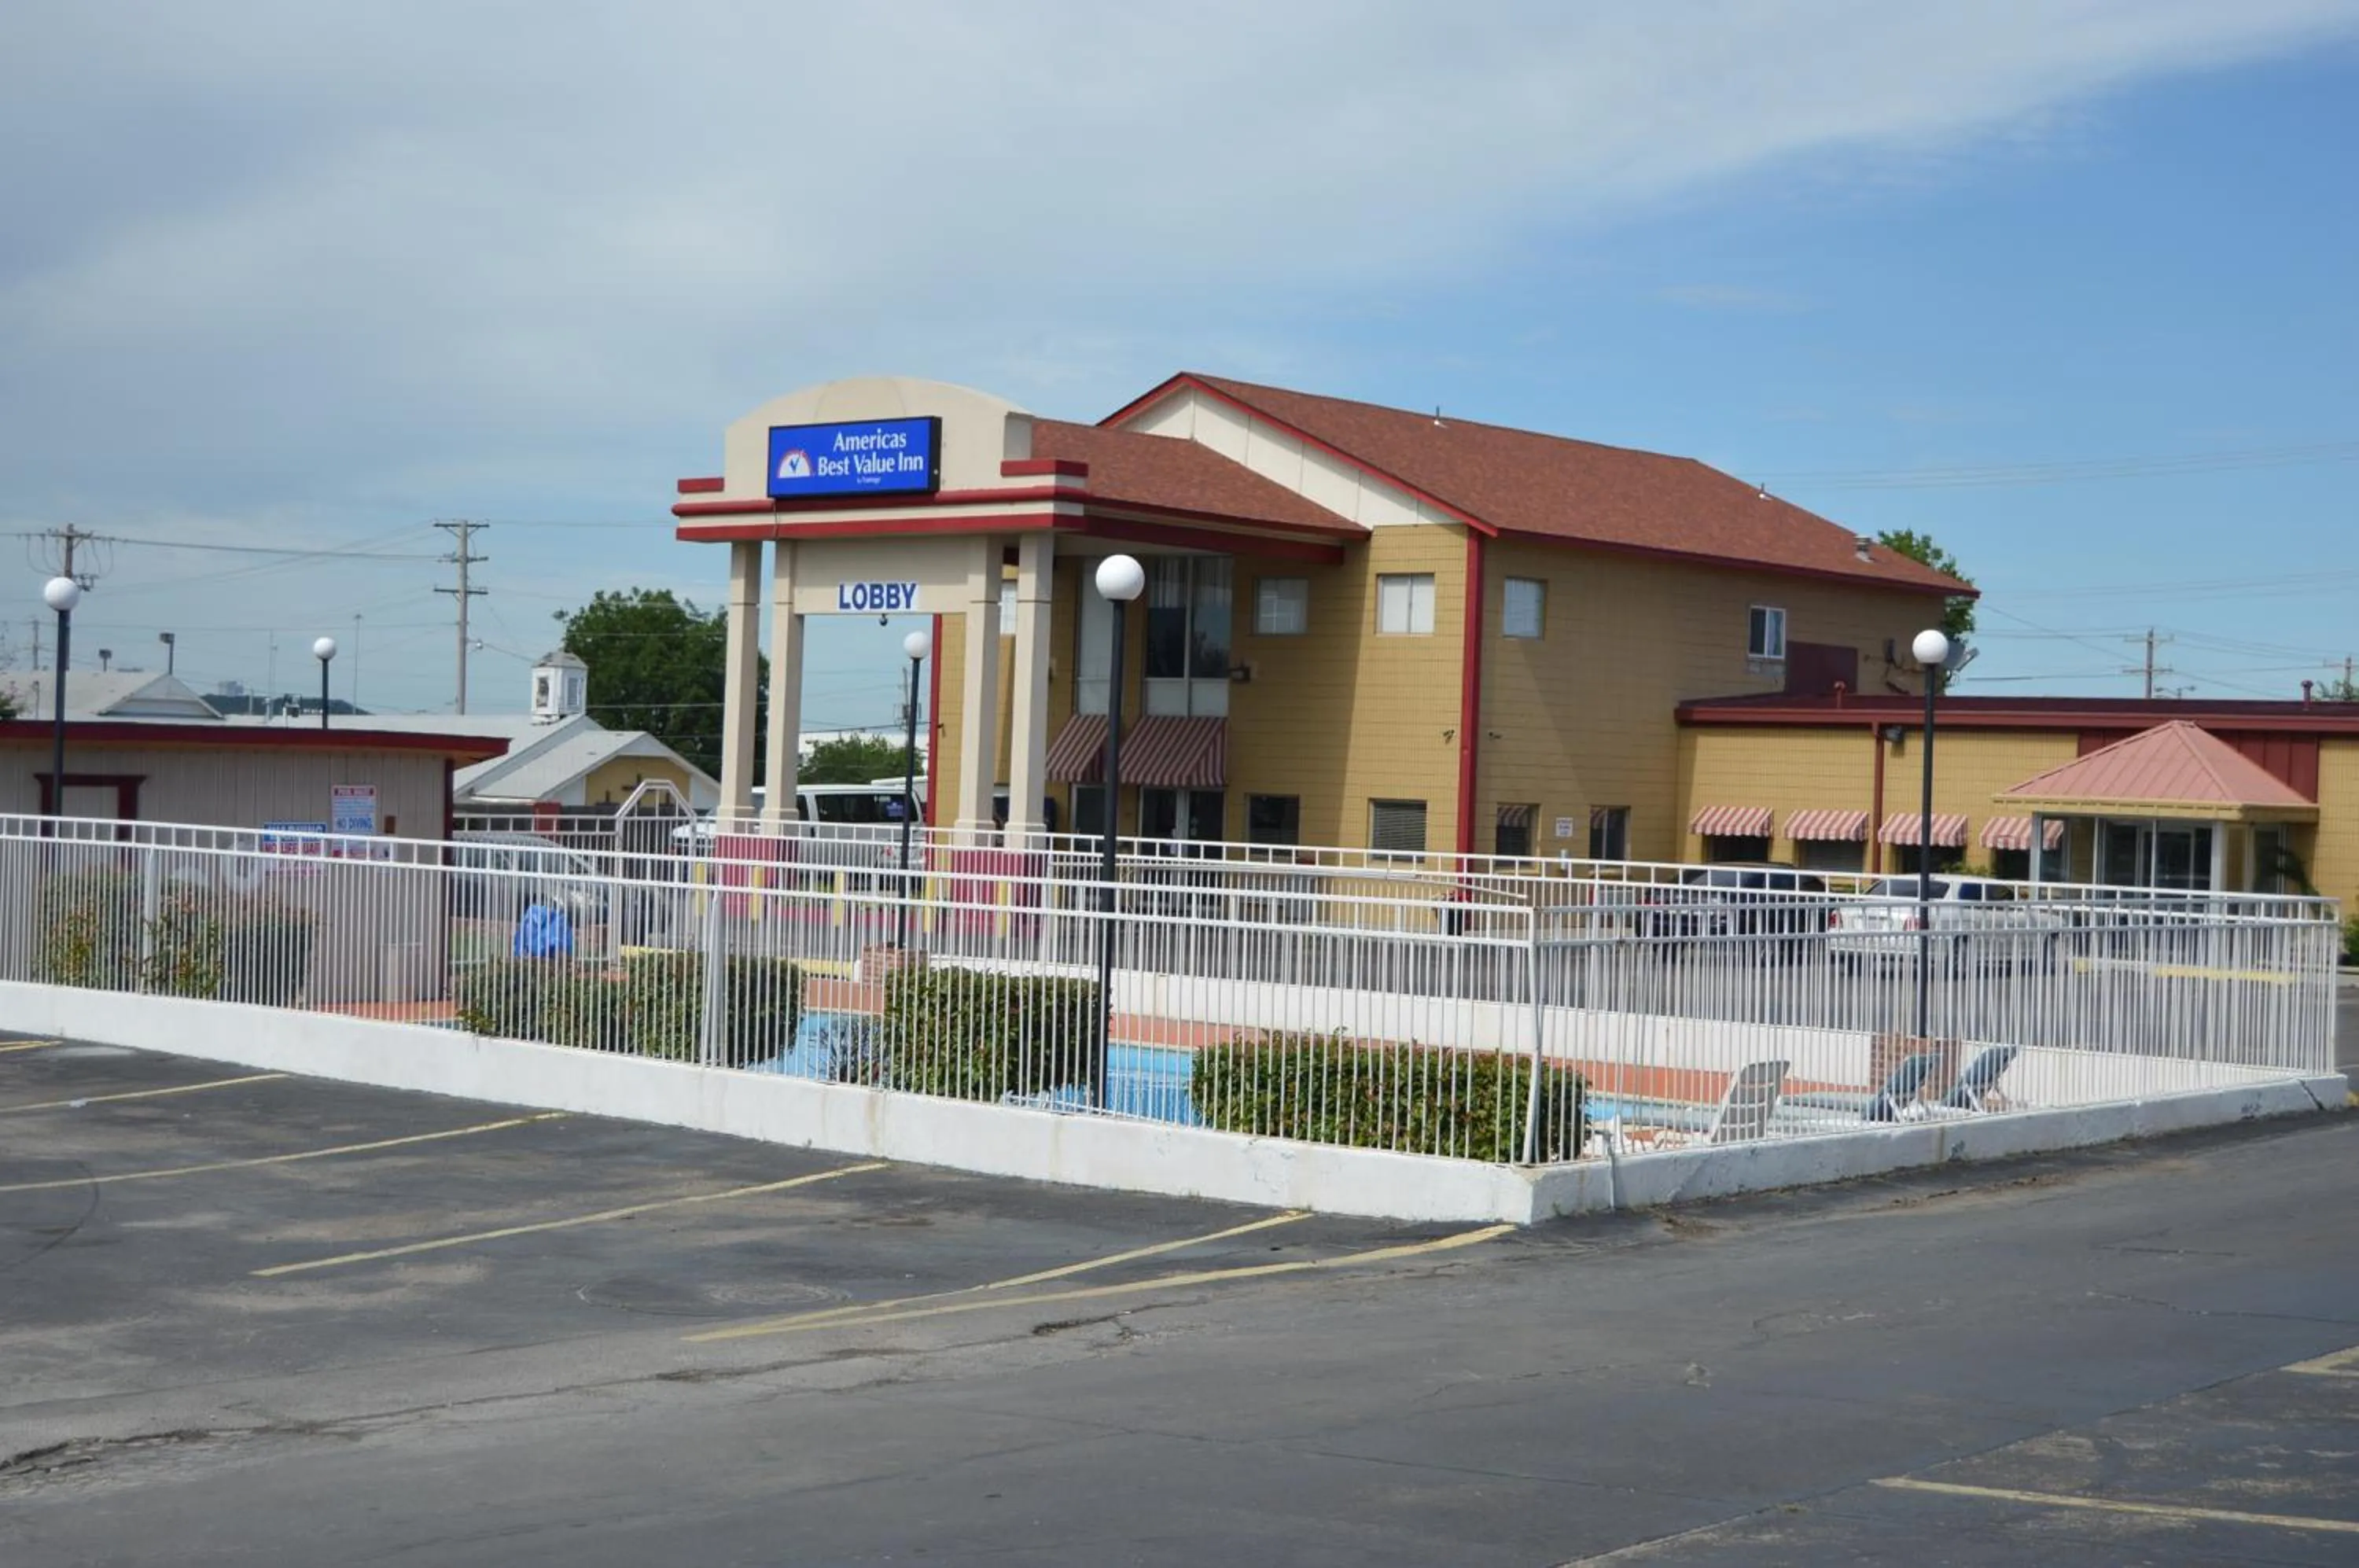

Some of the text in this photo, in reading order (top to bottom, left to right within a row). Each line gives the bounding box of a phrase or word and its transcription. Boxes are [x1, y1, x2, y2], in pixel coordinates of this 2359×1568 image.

[833, 428, 907, 451] Americas
[818, 451, 924, 477] Best Value Inn
[839, 583, 917, 609] LOBBY
[337, 817, 373, 830] NO DIVING
